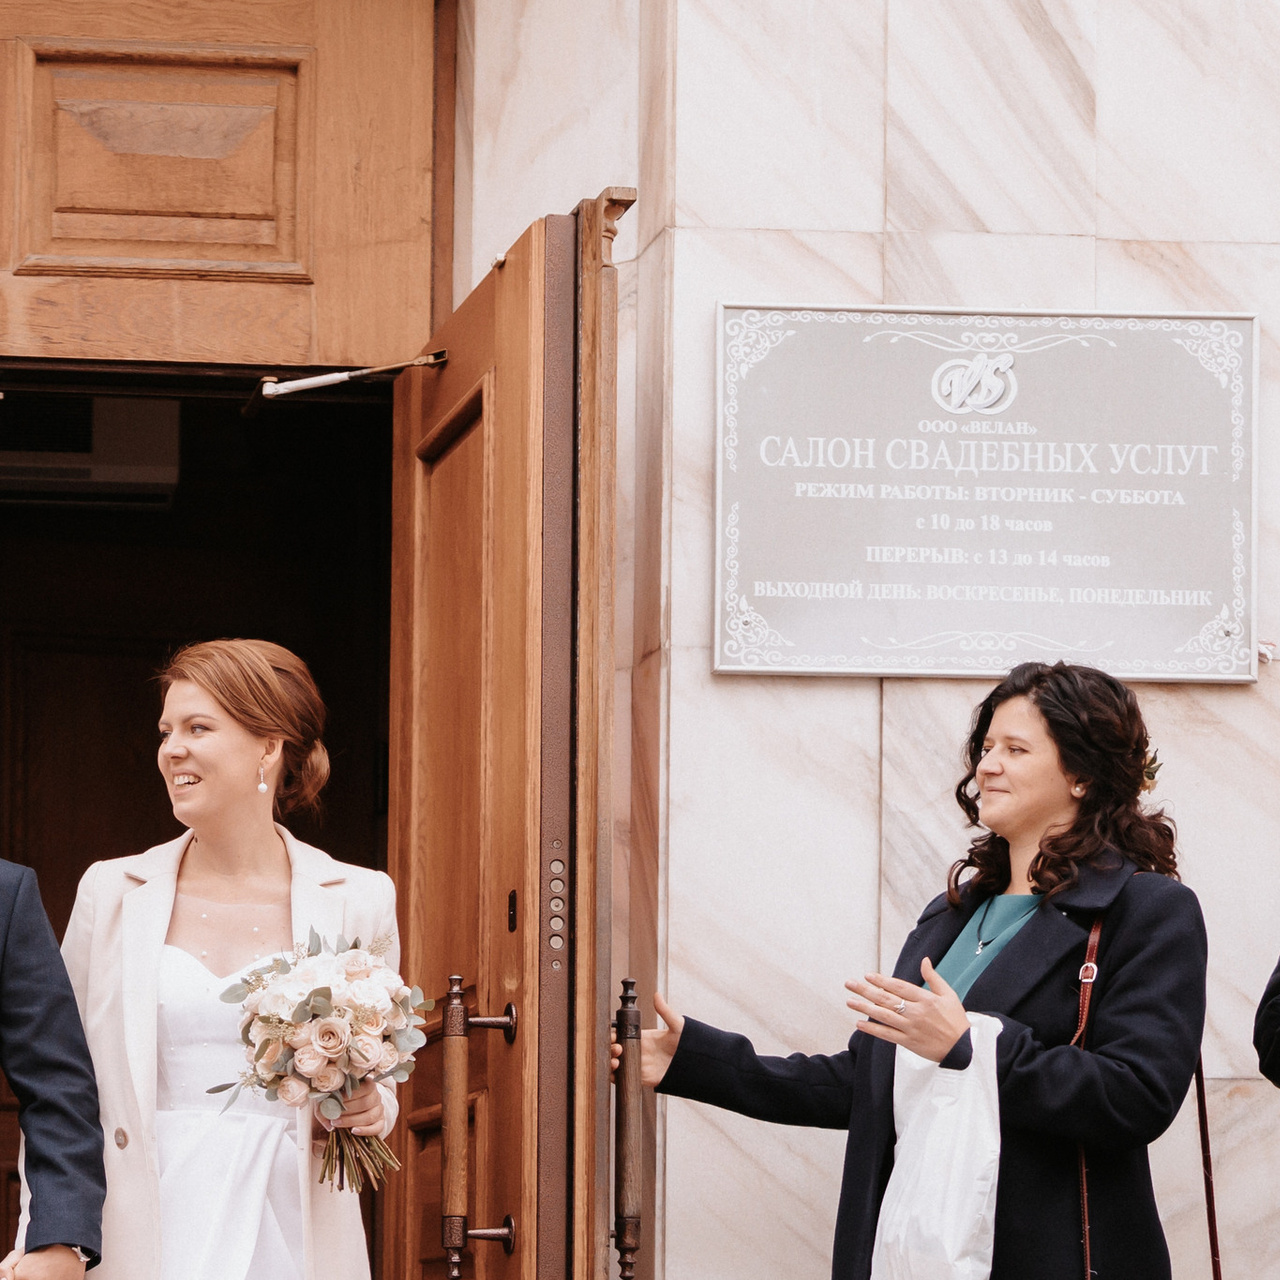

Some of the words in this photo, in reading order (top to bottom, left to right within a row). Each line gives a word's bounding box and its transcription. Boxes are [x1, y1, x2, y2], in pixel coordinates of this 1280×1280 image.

[917, 419, 958, 434] ООО
[960, 420, 1038, 436] «ВЕЛАН»
[759, 435, 876, 469] САЛОН
[885, 438, 1099, 478] СВАДЕБНЫХ
[1108, 443, 1219, 476] УСЛУГ
[794, 482, 875, 500] РЕЖИМ
[880, 484, 970, 502] РАБОТЫ:
[974, 485, 1075, 504] ВТОРНИК
[1091, 488, 1186, 505] СУББОТА
[915, 517, 925, 530] с
[930, 513, 950, 531] 10
[954, 517, 976, 532] до
[980, 514, 1001, 531] 18
[1004, 518, 1054, 532] часов
[865, 545, 970, 565] ПЕРЕРЫВ:
[988, 549, 1008, 566] 13
[1012, 552, 1034, 567] до
[1037, 550, 1058, 567] 14
[1062, 553, 1112, 568] часов
[753, 579, 864, 600] ВЫХОДНОЙ
[867, 583, 922, 601] ДЕНЬ:
[926, 584, 1064, 606] ВОСКРЕСЕНЬЕ,
[1069, 587, 1213, 608] ПОНЕДЕЛЬНИК
